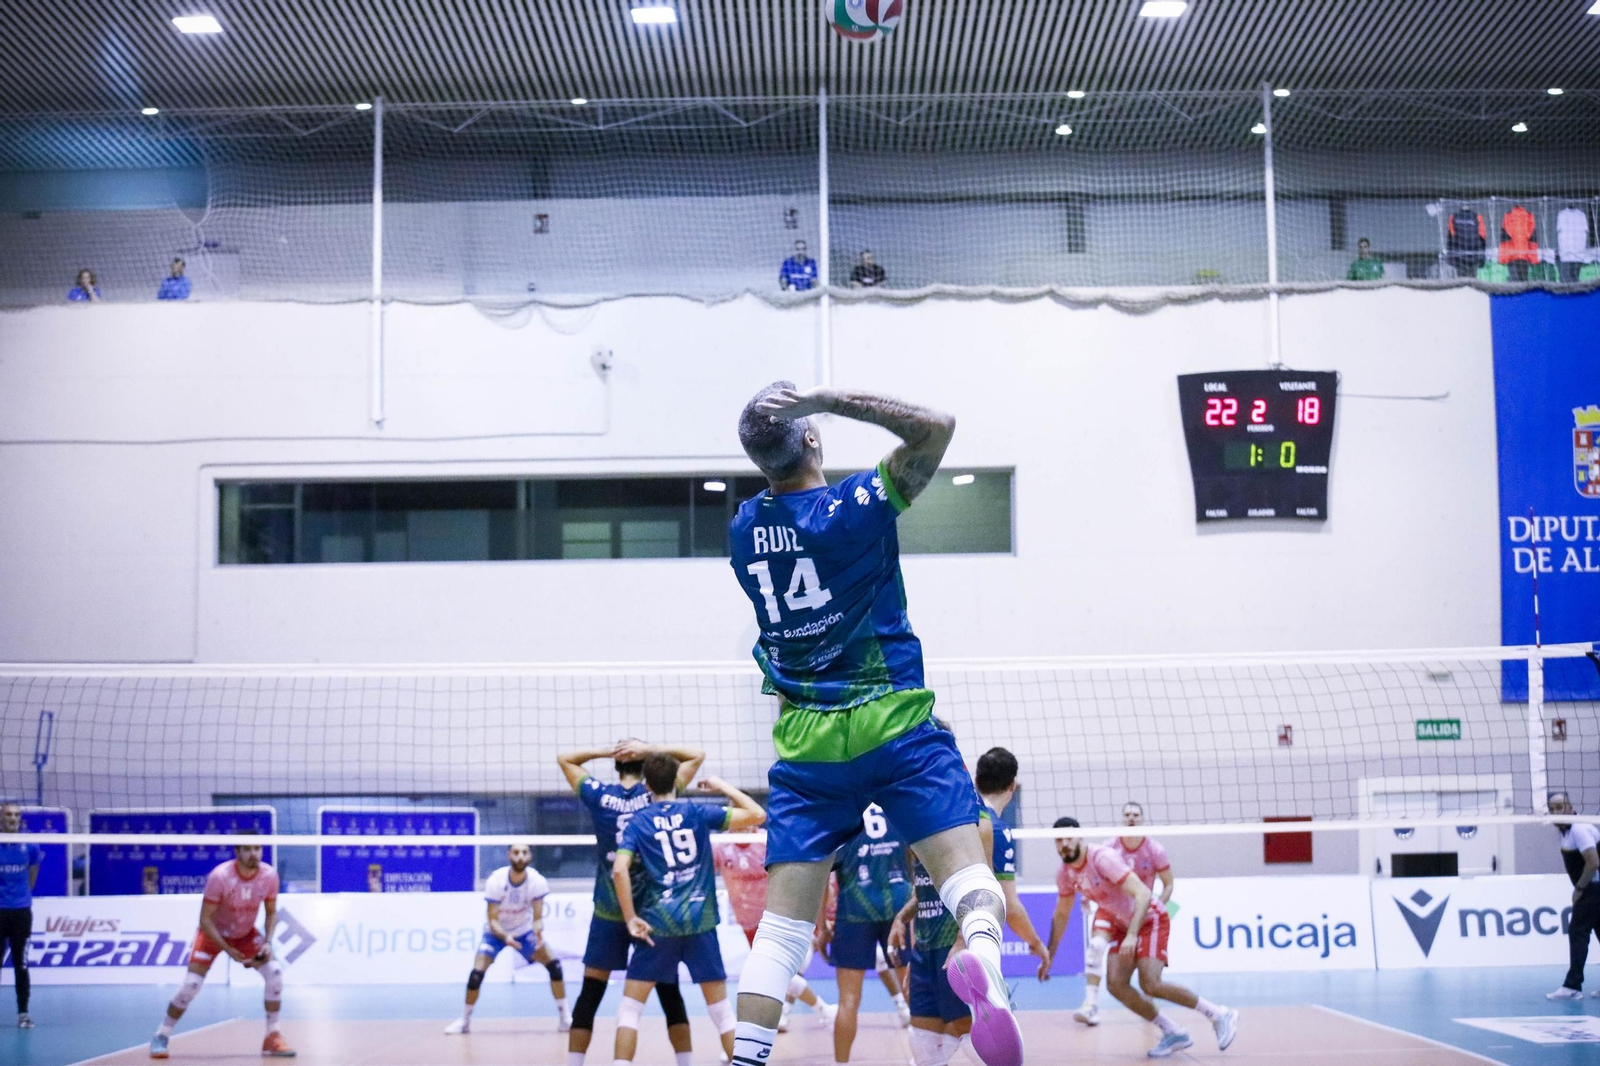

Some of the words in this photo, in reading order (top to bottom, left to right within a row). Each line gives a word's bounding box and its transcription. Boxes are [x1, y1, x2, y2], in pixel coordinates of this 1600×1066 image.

[1203, 382, 1228, 393] LOCAL
[1279, 381, 1317, 392] VISITANTE
[1205, 398, 1238, 426] 22
[1251, 399, 1267, 423] 2
[1297, 397, 1320, 424] 18
[753, 526, 804, 554] RUIZ
[1507, 515, 1600, 542] DIPUT
[1512, 547, 1553, 573] DE
[1560, 546, 1600, 573] AL
[747, 557, 833, 624] 14
[1416, 723, 1460, 737] SALIDA
[653, 814, 684, 831] FILIP
[863, 802, 887, 839] 6
[654, 828, 698, 868] 19
[45, 915, 120, 937] Viajes
[1193, 914, 1356, 958] Unicaja
[328, 924, 476, 957] Alprosa
